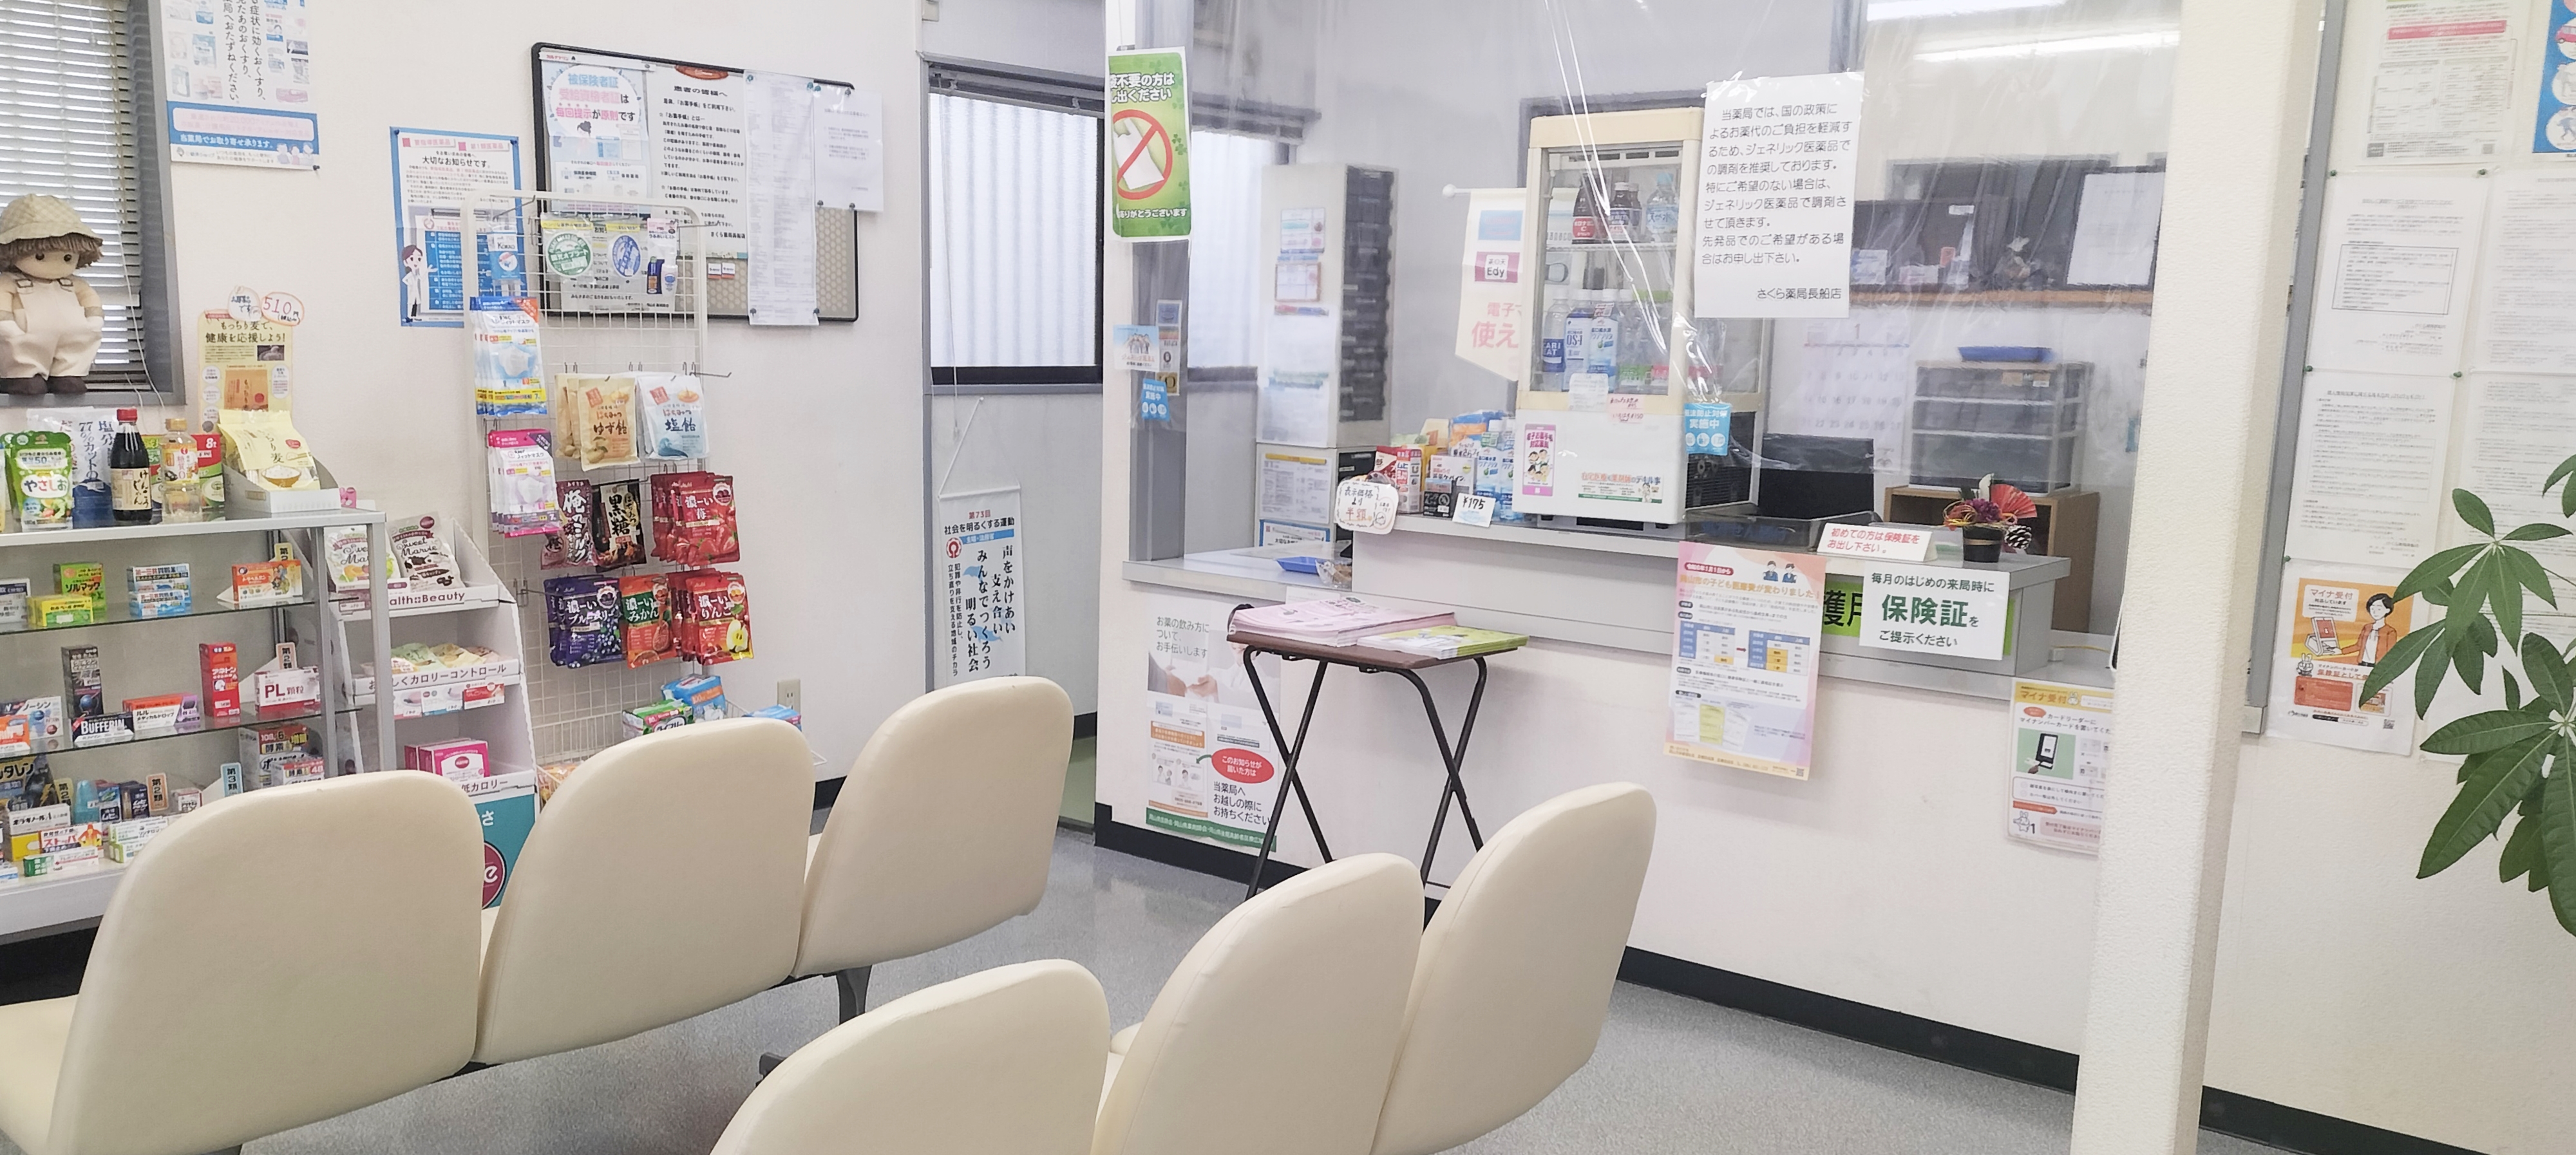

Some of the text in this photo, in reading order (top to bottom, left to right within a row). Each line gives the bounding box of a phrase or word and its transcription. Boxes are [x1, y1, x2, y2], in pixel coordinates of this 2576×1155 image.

[568, 73, 618, 88] 被保険者証
[674, 85, 728, 97] 患者の皆様へ
[556, 107, 635, 122] 毎回提示が原則です
[1722, 103, 1837, 120] 当薬局では、国の政策に
[1709, 121, 1852, 139] よるお薬代のご負担を軽減す
[1708, 140, 1851, 157] るため、ジェネリック医薬品で
[1707, 159, 1837, 175] の調剤を推奨しております。
[1706, 178, 1831, 192] 特にご希望のない場合は、
[1705, 196, 1846, 211] ジェネリック医薬品で調剤さ
[1704, 218, 1770, 229] せて頂きます。
[1703, 234, 1844, 247] 先発品でのご希望がある場
[1702, 253, 1800, 265] 合はお申し出下さい。
[1487, 267, 1505, 277] Edy
[1757, 287, 1842, 300] さくら薬局長船店
[221, 320, 273, 331] もっちり麦で、
[205, 332, 286, 343] 健康を応援しよう!
[1567, 335, 1582, 346] OS-1
[593, 419, 627, 435] ゆず飴
[665, 417, 697, 432] 塩飴
[1689, 419, 1719, 429] 実施中
[79, 421, 99, 480] 77%カットの
[24, 478, 68, 493] やさしお
[1343, 487, 1373, 498] 表示価格
[685, 495, 714, 508] 濃ーい
[1351, 498, 1363, 506] より
[1463, 496, 1485, 510] ¥175
[609, 494, 631, 536] 黒糖
[625, 493, 638, 527] はちみつ
[969, 510, 990, 519] 第73回
[1345, 506, 1367, 520] 半額
[563, 489, 587, 564] 俺のミルク
[944, 517, 1015, 535] 社会を明るくする運動
[396, 536, 428, 550] Sweet
[1831, 528, 1920, 544] 初めての方は保険証を
[343, 545, 368, 555] Swe
[1827, 539, 1887, 554] お出し下さい。
[66, 582, 101, 592] ソルマック
[1002, 545, 1016, 634] 声をかけあい
[1871, 572, 1995, 592] 毎月のはじめの来局時に
[390, 596, 413, 605] alth
[954, 563, 963, 639] 犯罪や非行を防止し、
[2311, 588, 2353, 600] マイナ受付
[567, 599, 598, 613] 濃ーい
[625, 598, 654, 612] 濃ーい
[698, 596, 728, 609] 濃ーい
[977, 550, 991, 670] みんなでつくろう
[992, 574, 1003, 634] 支え合い
[568, 609, 614, 624] ブルーベリー
[628, 608, 659, 622] みかん
[701, 608, 732, 620] りんご
[1882, 594, 1979, 628] 保険証を
[948, 564, 958, 677] 立ち直りを支える地域のチカラ
[1157, 616, 1209, 633] お薬の飲み方に
[965, 597, 979, 673] 明るい社会
[1156, 629, 1182, 642] ついて、
[1879, 630, 1958, 648] ご提示ください
[1156, 642, 1208, 659] お手伝いします
[2020, 691, 2068, 704] マイナ受付
[23, 700, 52, 711] ノーシン
[81, 719, 126, 735] BUFFERIN
[2048, 713, 2097, 726] カードリーダーに
[1222, 756, 1262, 768] このお知らせが
[1227, 765, 1256, 776] 届いた方は
[227, 768, 238, 791] 第3類
[151, 778, 163, 802] 第2類
[1213, 781, 1245, 796] 当薬局へ
[1213, 794, 1262, 812] お越しの際に
[1213, 807, 1271, 825] お持ちください
[44, 836, 77, 847] ストッパ
